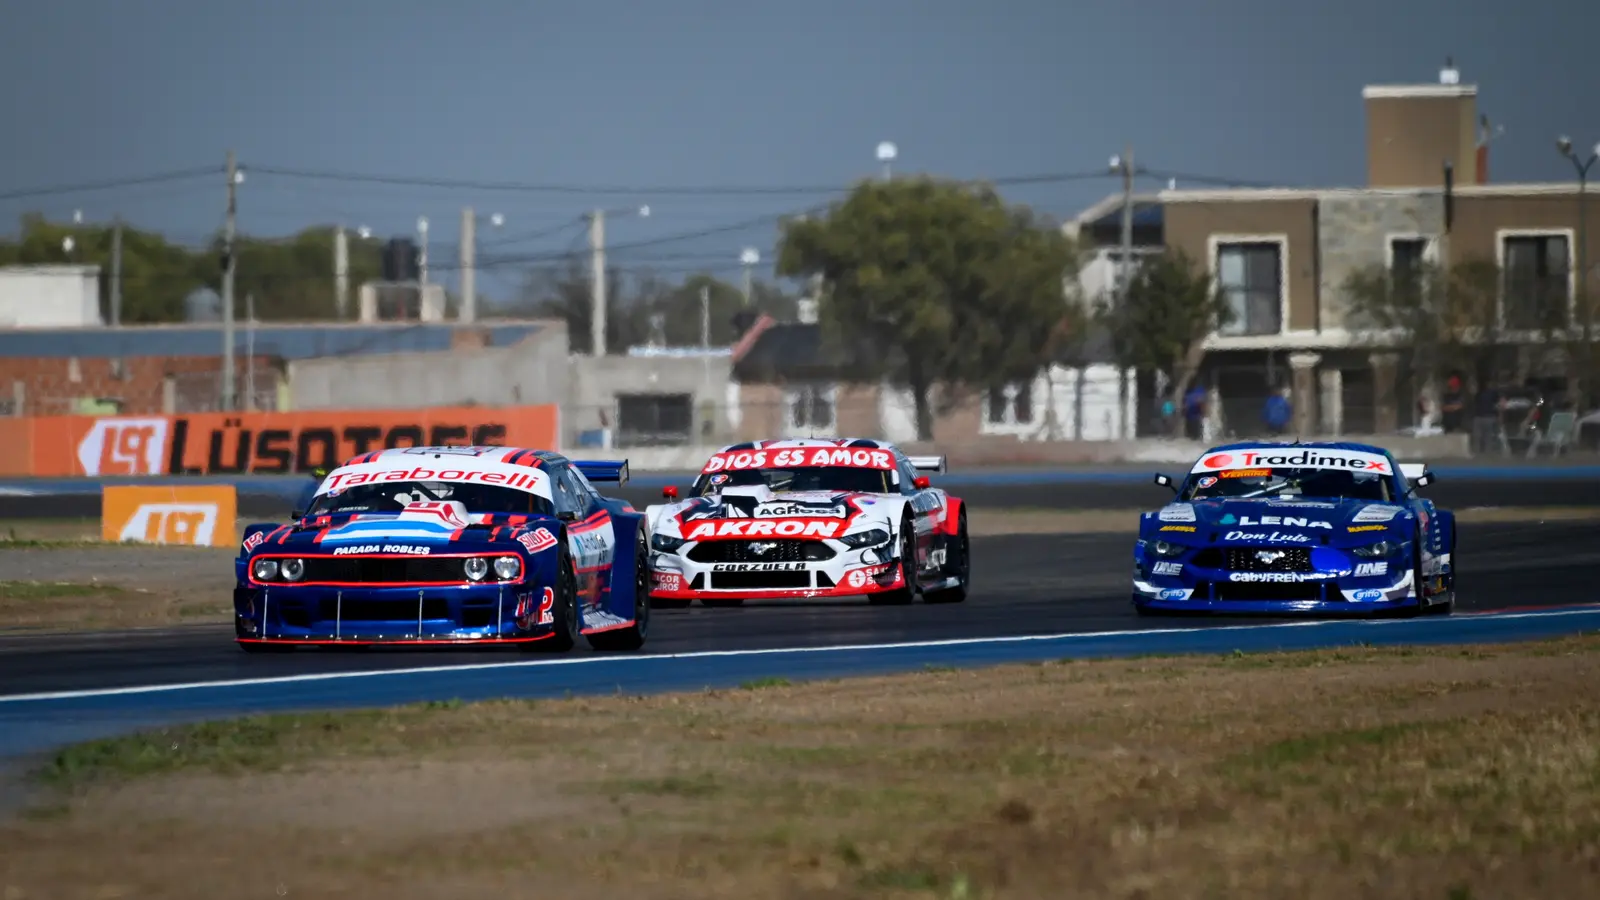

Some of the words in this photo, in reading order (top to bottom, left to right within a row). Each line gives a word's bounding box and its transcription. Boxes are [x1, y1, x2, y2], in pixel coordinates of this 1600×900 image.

[705, 452, 766, 472] DIOS
[773, 450, 805, 466] ES
[811, 449, 890, 468] AMOR
[1241, 451, 1386, 472] Tradimex
[329, 466, 540, 490] Taraborelli
[688, 520, 840, 538] AKRON
[1239, 516, 1334, 529] LENA
[1225, 531, 1268, 541] Don
[1268, 531, 1311, 542] Luis
[333, 545, 380, 555] PARADA
[382, 544, 431, 555] ROBLES
[1356, 588, 1380, 600] griffo
